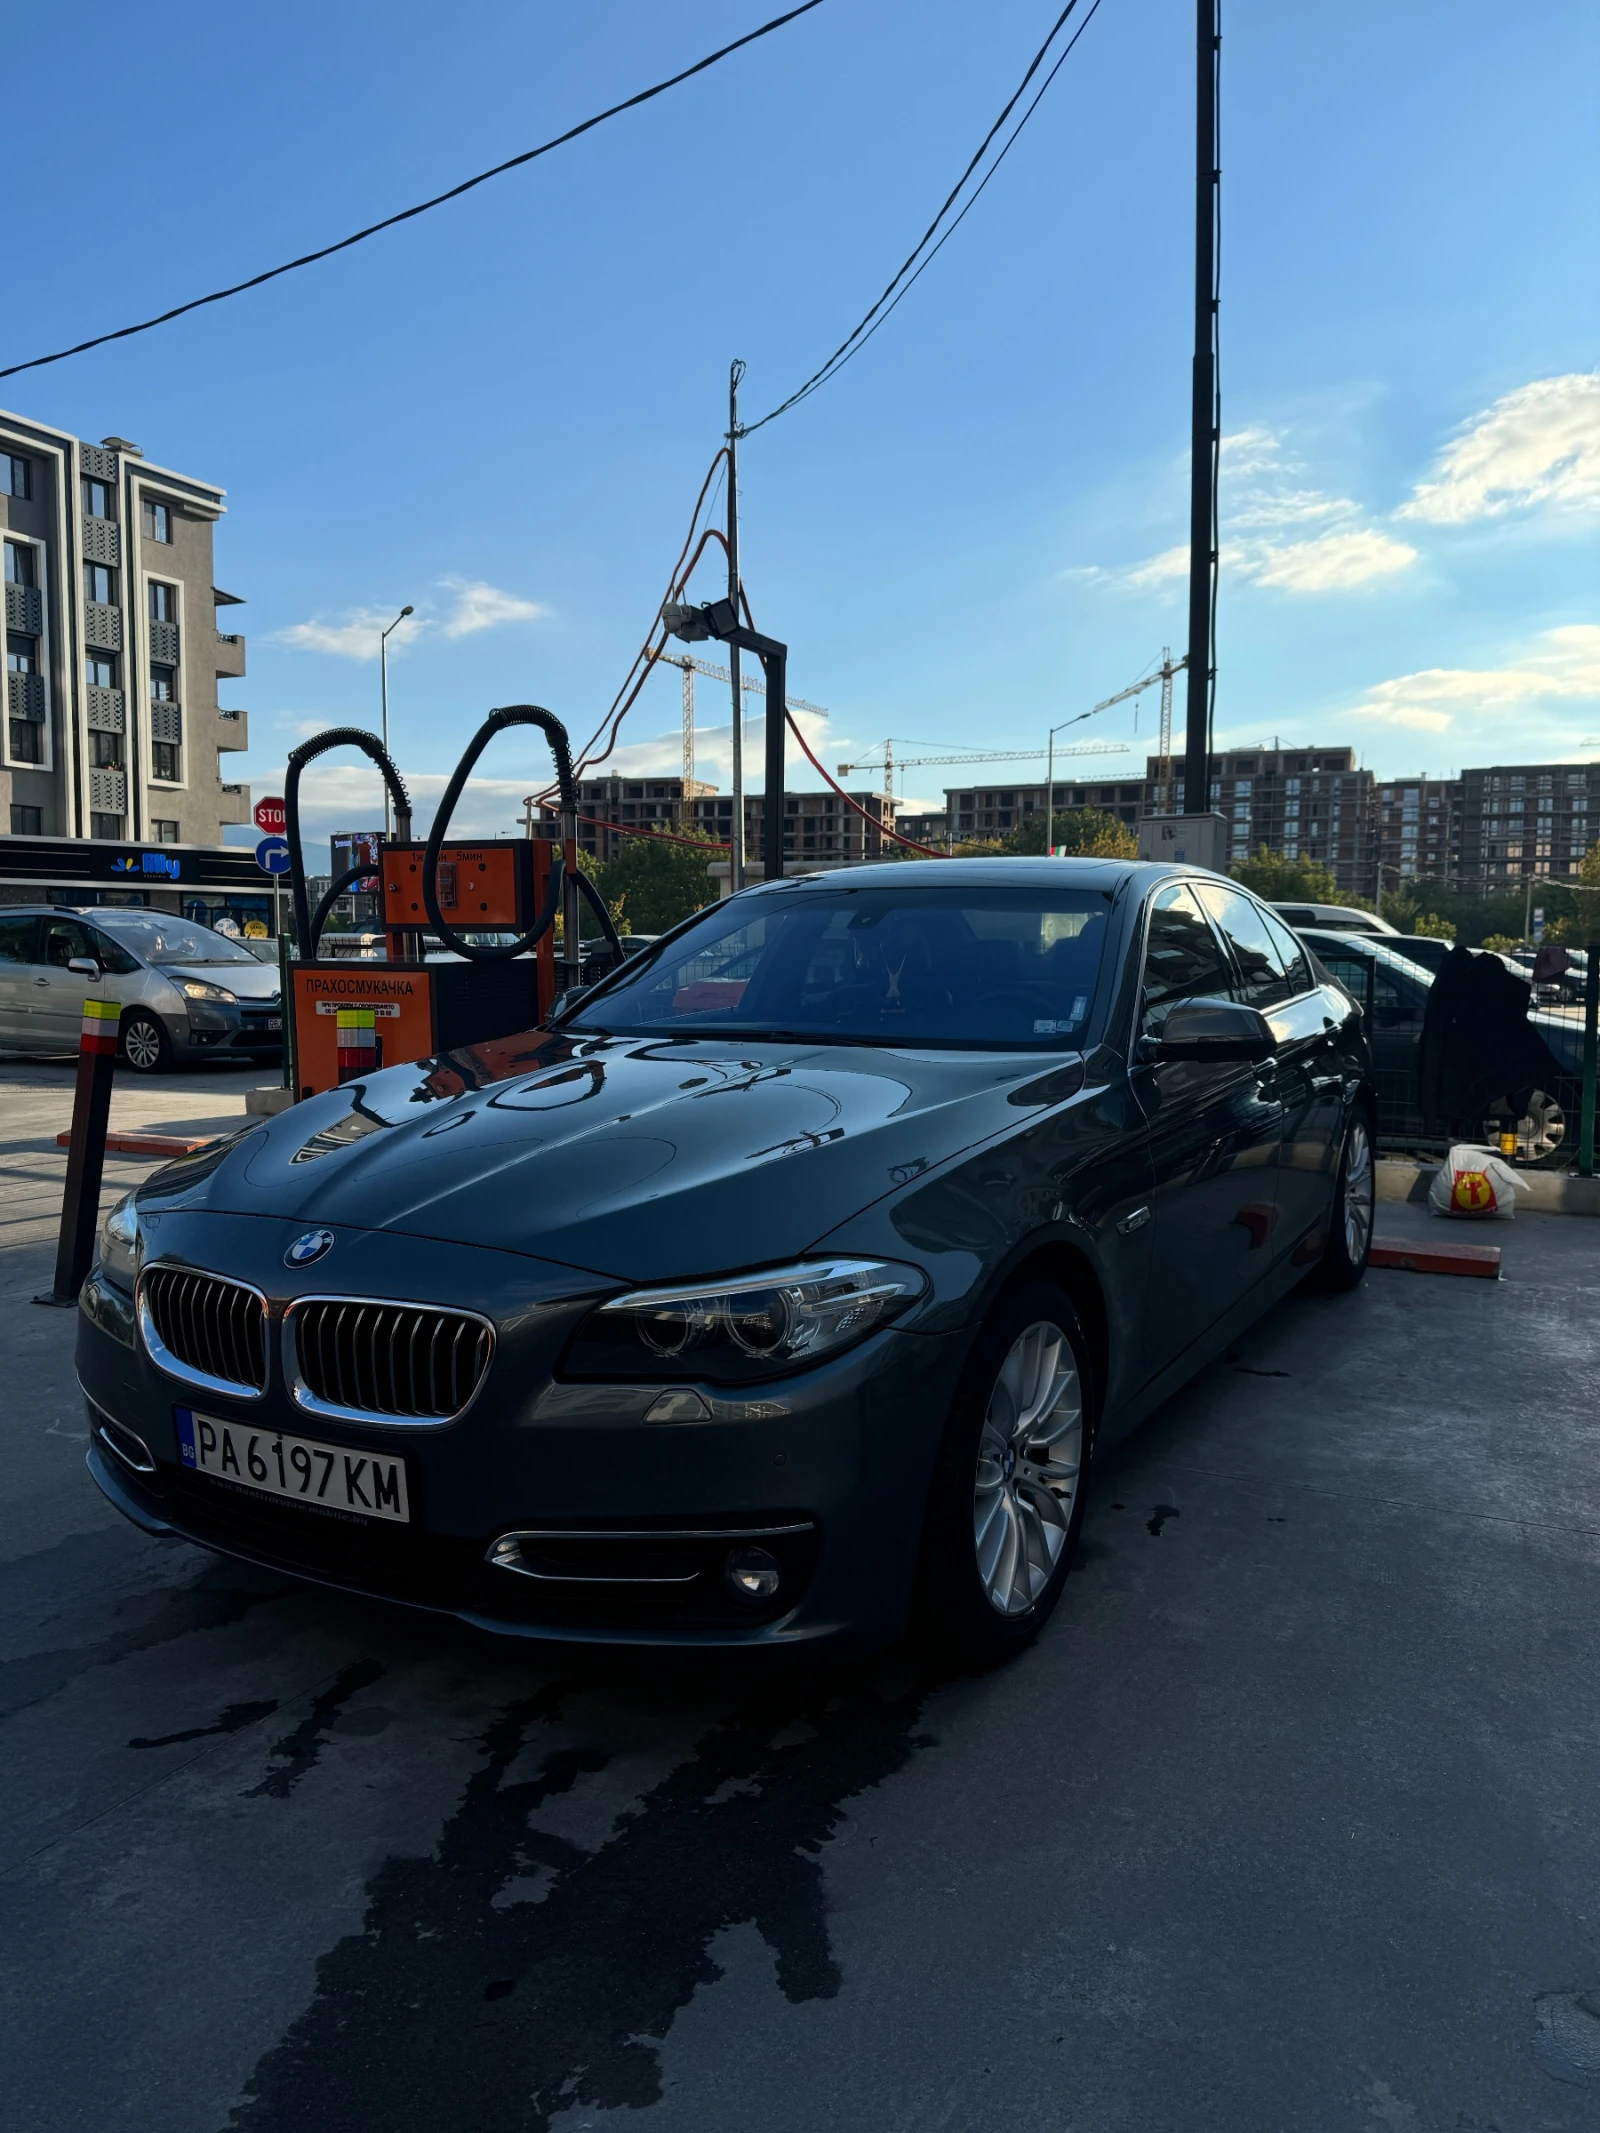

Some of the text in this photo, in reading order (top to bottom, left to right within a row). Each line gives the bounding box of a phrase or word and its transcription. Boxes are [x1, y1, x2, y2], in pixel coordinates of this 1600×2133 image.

[456, 851, 483, 862] 5мин
[142, 853, 181, 879] lilly
[306, 979, 414, 995] ПРАХОСМУКАЧКА
[182, 1443, 195, 1459] BG
